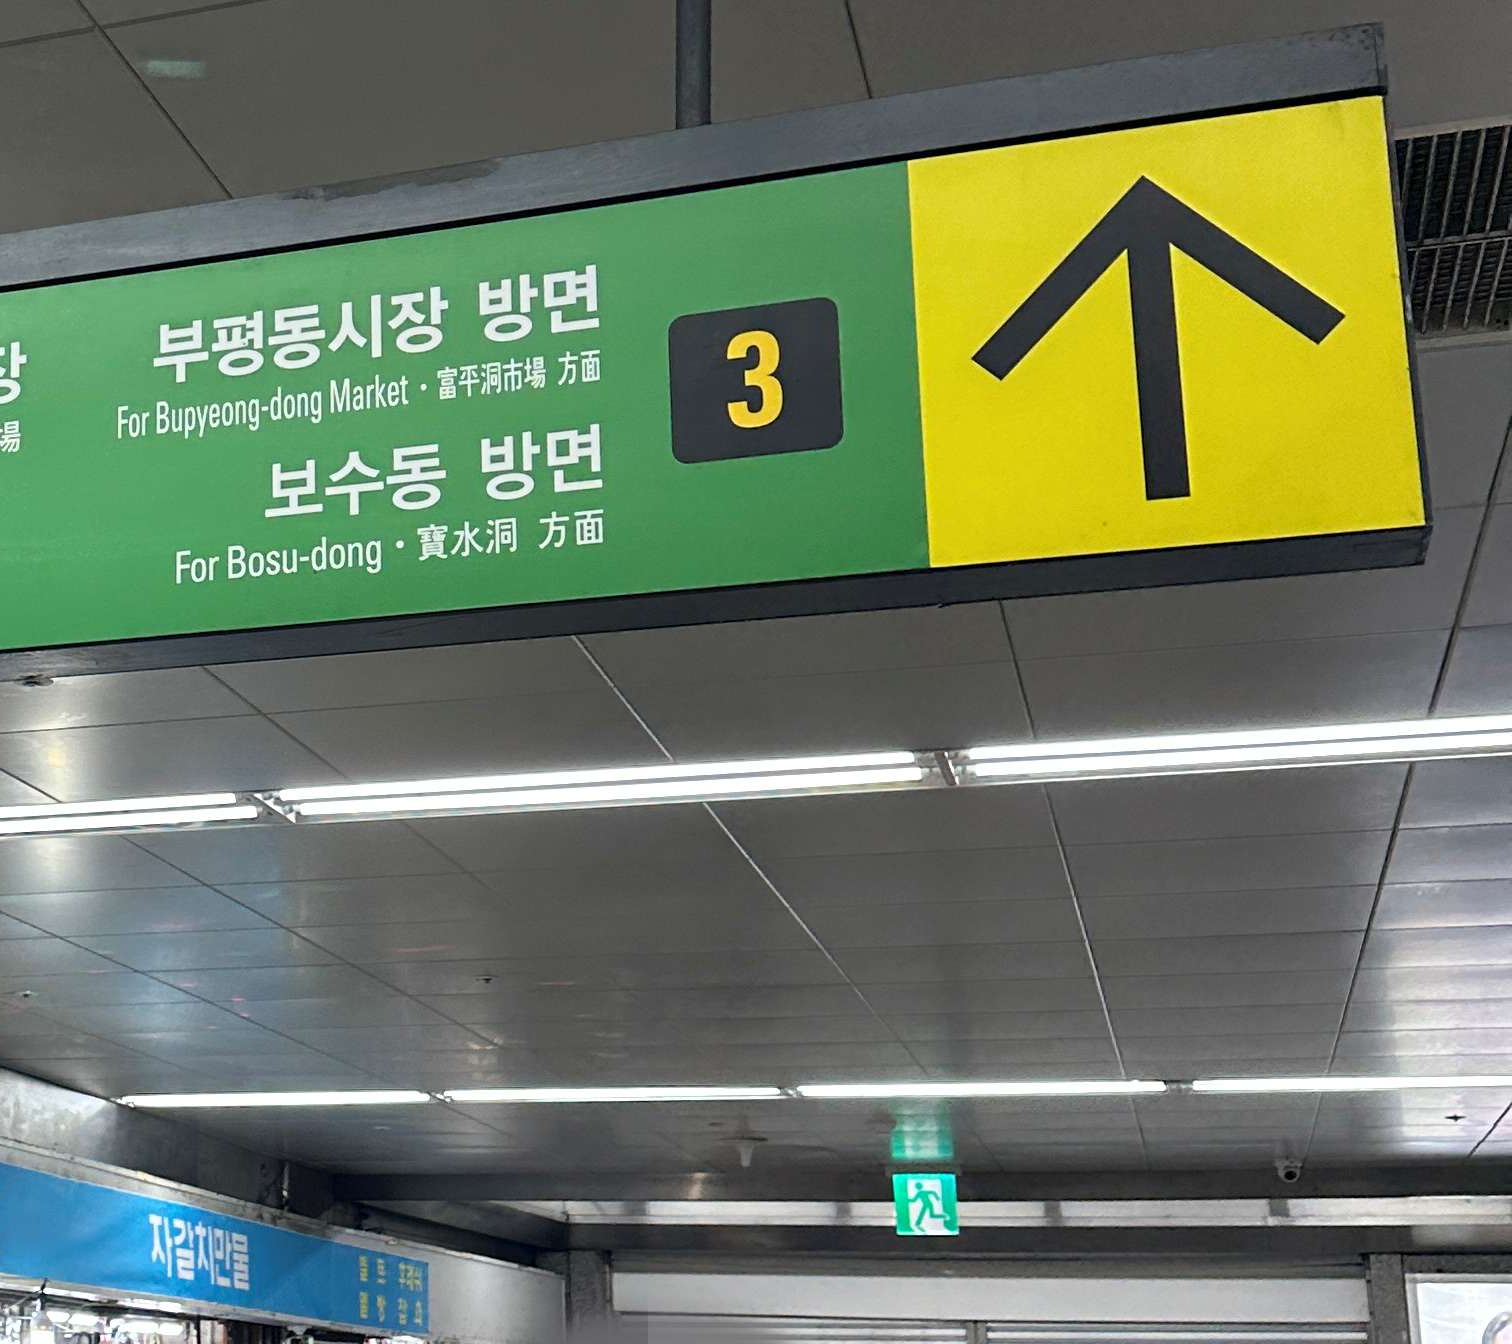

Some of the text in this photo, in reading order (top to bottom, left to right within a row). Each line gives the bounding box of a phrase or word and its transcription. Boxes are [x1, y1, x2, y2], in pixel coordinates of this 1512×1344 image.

[153, 264, 600, 383] 부평동시장 방면
[117, 349, 601, 439] For Bupyeong-dong Market 富平洞市場 方面
[726, 330, 783, 429] 3
[264, 423, 603, 518] 보수동 방면
[175, 550, 220, 584] For
[227, 536, 382, 579] Bosu-dong
[538, 509, 604, 549] 方面
[148, 1214, 249, 1290] 자갈치만물
